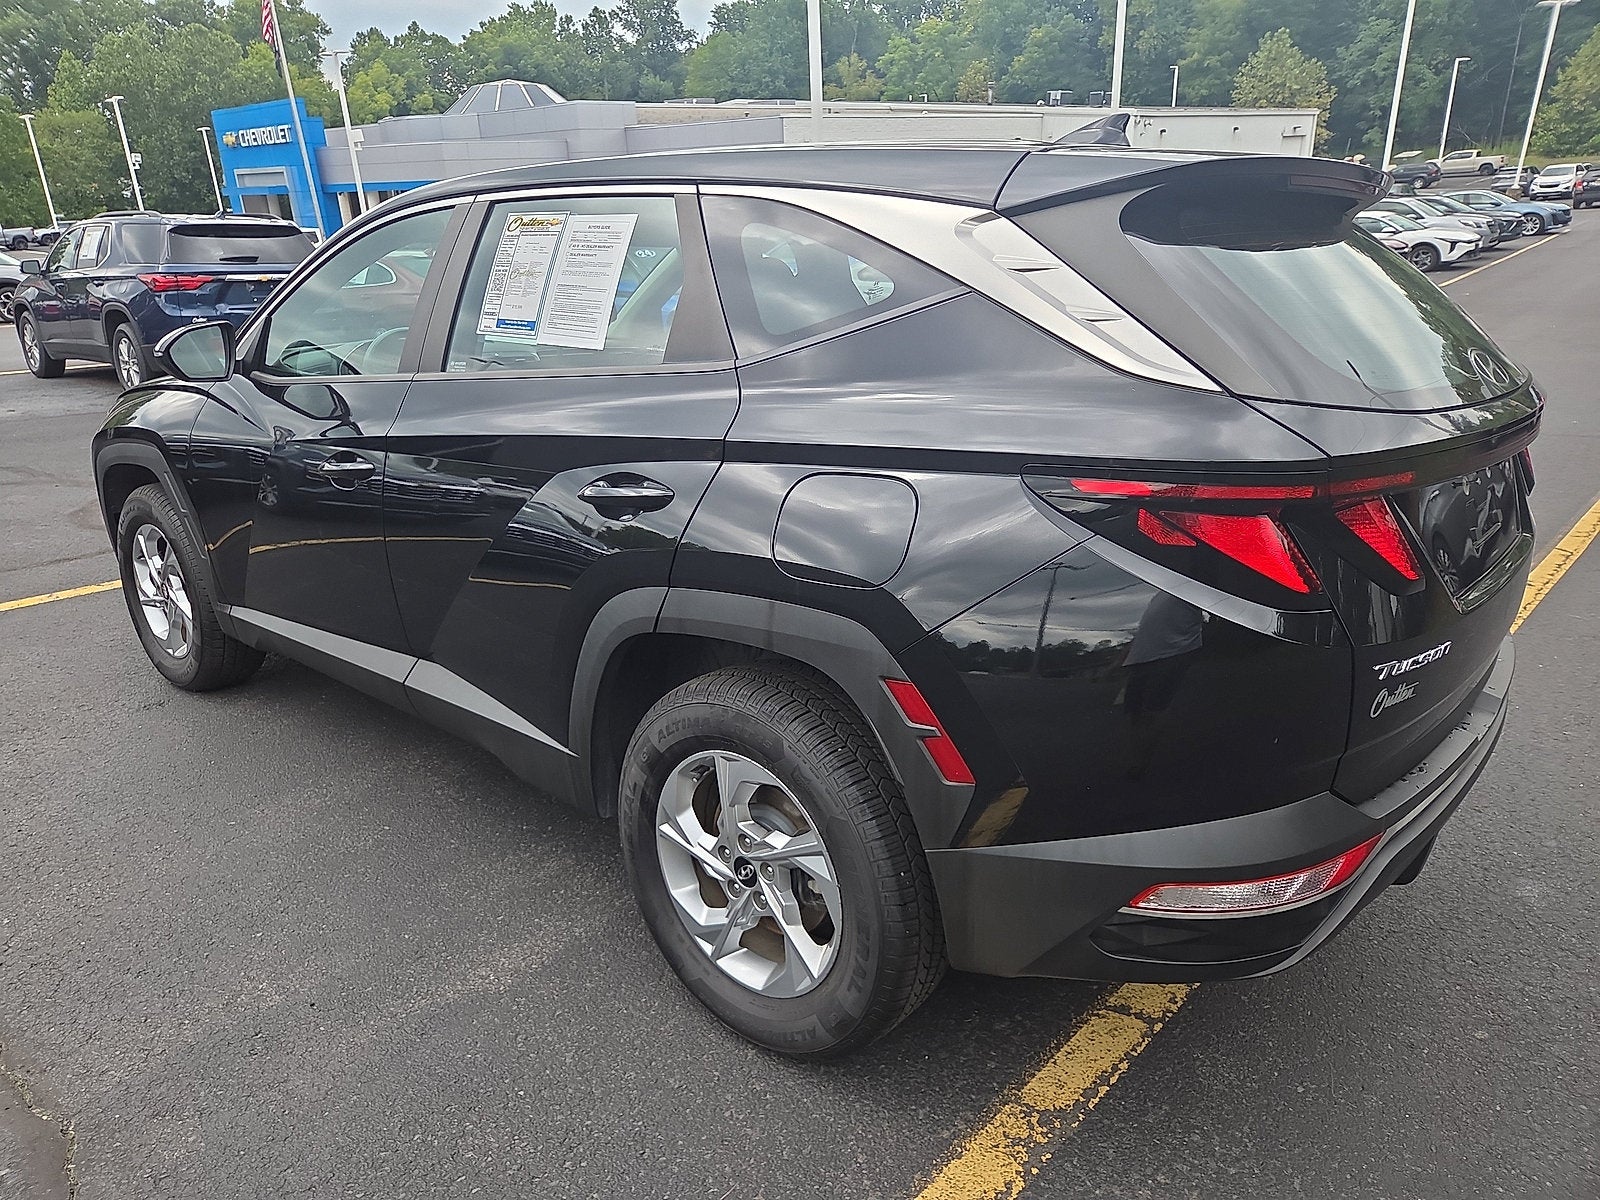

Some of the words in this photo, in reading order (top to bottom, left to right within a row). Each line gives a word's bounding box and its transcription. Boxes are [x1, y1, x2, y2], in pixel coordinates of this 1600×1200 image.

[239, 125, 291, 147] CHEVROLET
[507, 217, 549, 232] Outten
[1370, 682, 1419, 718] Outten
